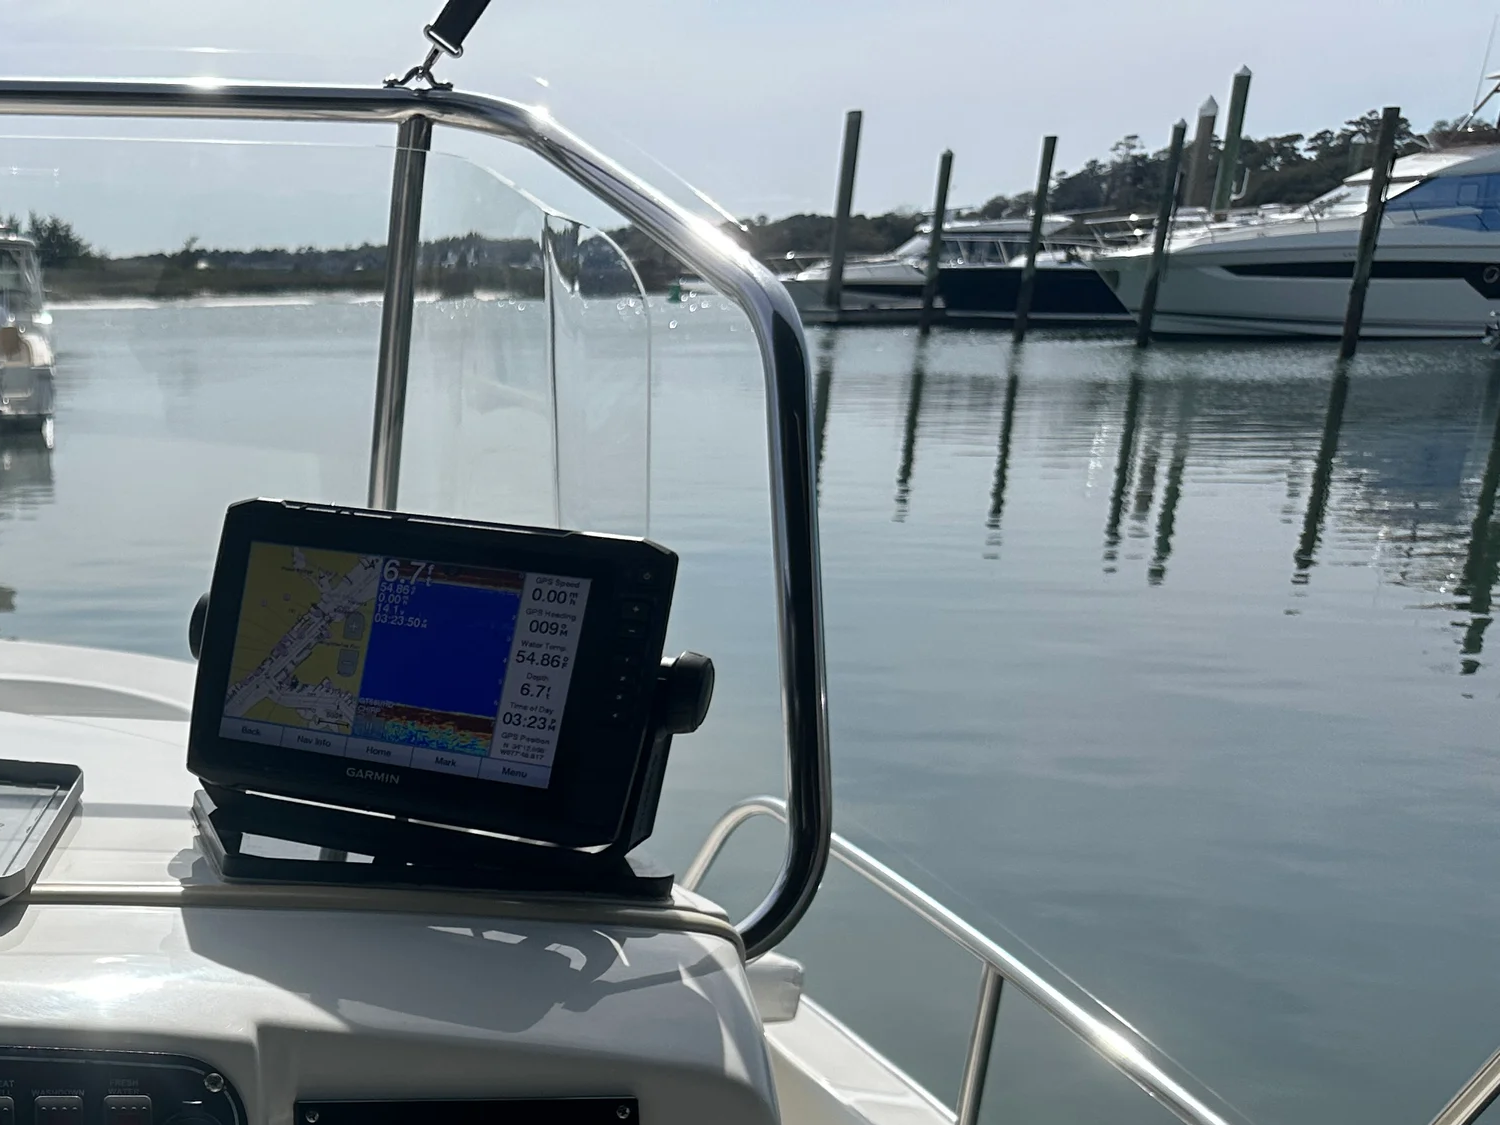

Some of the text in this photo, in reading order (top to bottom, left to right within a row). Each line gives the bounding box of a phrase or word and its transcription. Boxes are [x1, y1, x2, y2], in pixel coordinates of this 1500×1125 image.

[383, 559, 426, 586] 6.7
[535, 577, 580, 589] GPS Speed
[532, 588, 567, 604] 0.00
[529, 620, 559, 635] 009
[516, 650, 560, 668] 54.86
[520, 683, 545, 698] 6.7
[539, 706, 555, 715] Day
[503, 712, 547, 730] 03:23
[241, 725, 261, 737] Back
[297, 734, 332, 748] Nav Info
[366, 746, 392, 758] Home
[435, 756, 457, 768] Mark
[345, 767, 400, 786] GARMIN
[502, 766, 528, 778] Menu
[110, 1079, 139, 1087] FRESH
